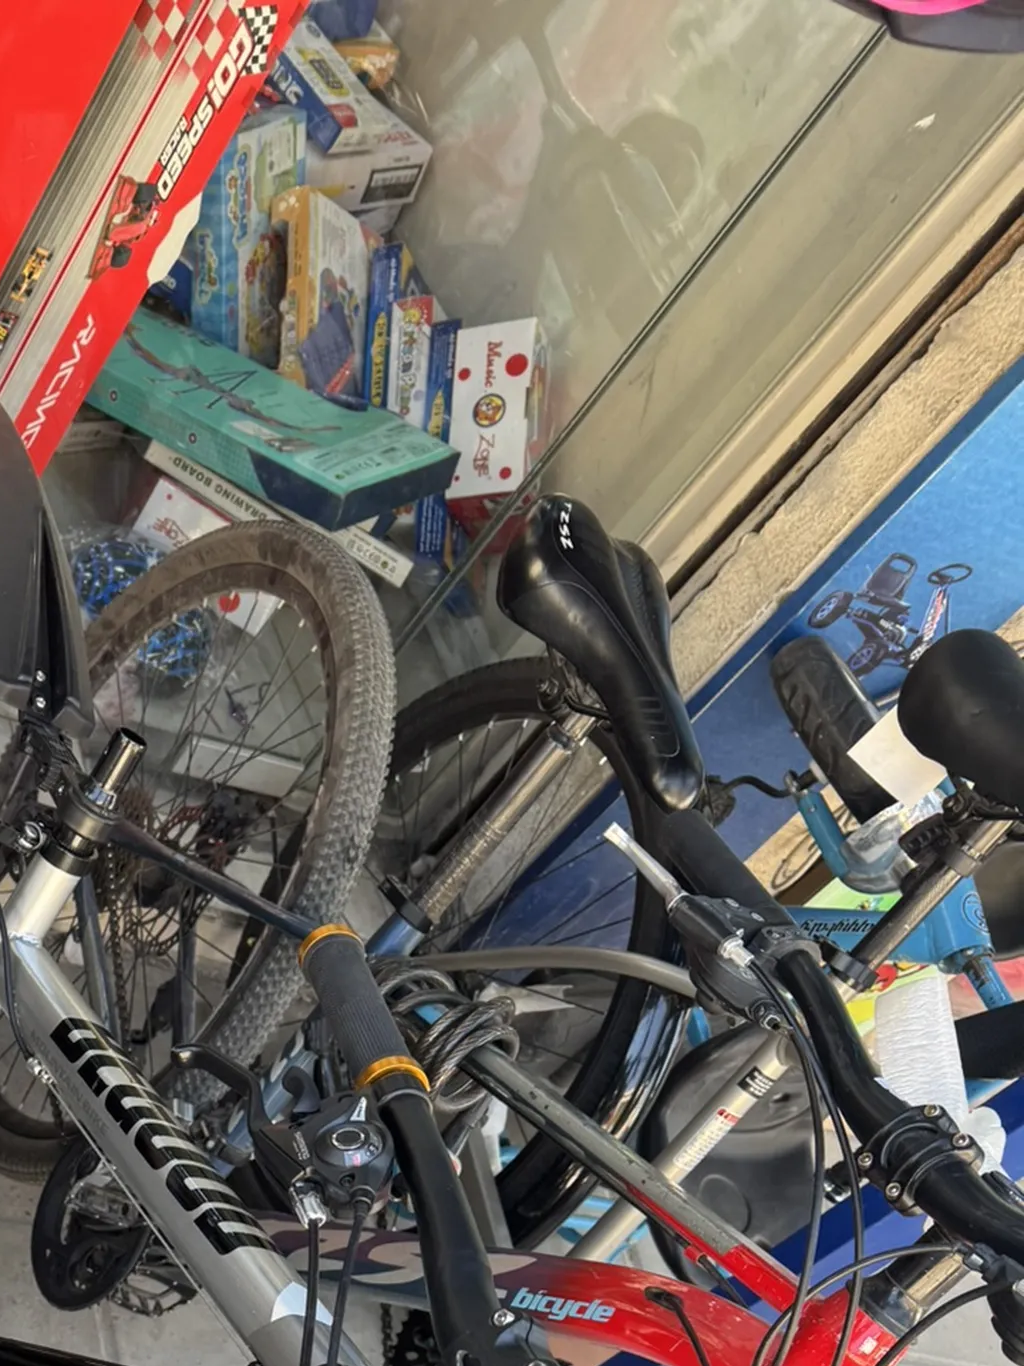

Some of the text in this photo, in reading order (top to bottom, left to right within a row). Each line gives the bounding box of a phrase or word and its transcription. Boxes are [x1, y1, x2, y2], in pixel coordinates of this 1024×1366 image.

[206, 28, 252, 109] GO!
[156, 95, 214, 200] SPEED
[158, 115, 187, 166] RACER
[20, 313, 97, 450] RACING
[483, 340, 504, 390] Music
[172, 456, 269, 524] DRAWING BOARD
[28, 1029, 109, 1134] MOUNTAIN BIKE
[510, 1286, 616, 1322] bicycle
